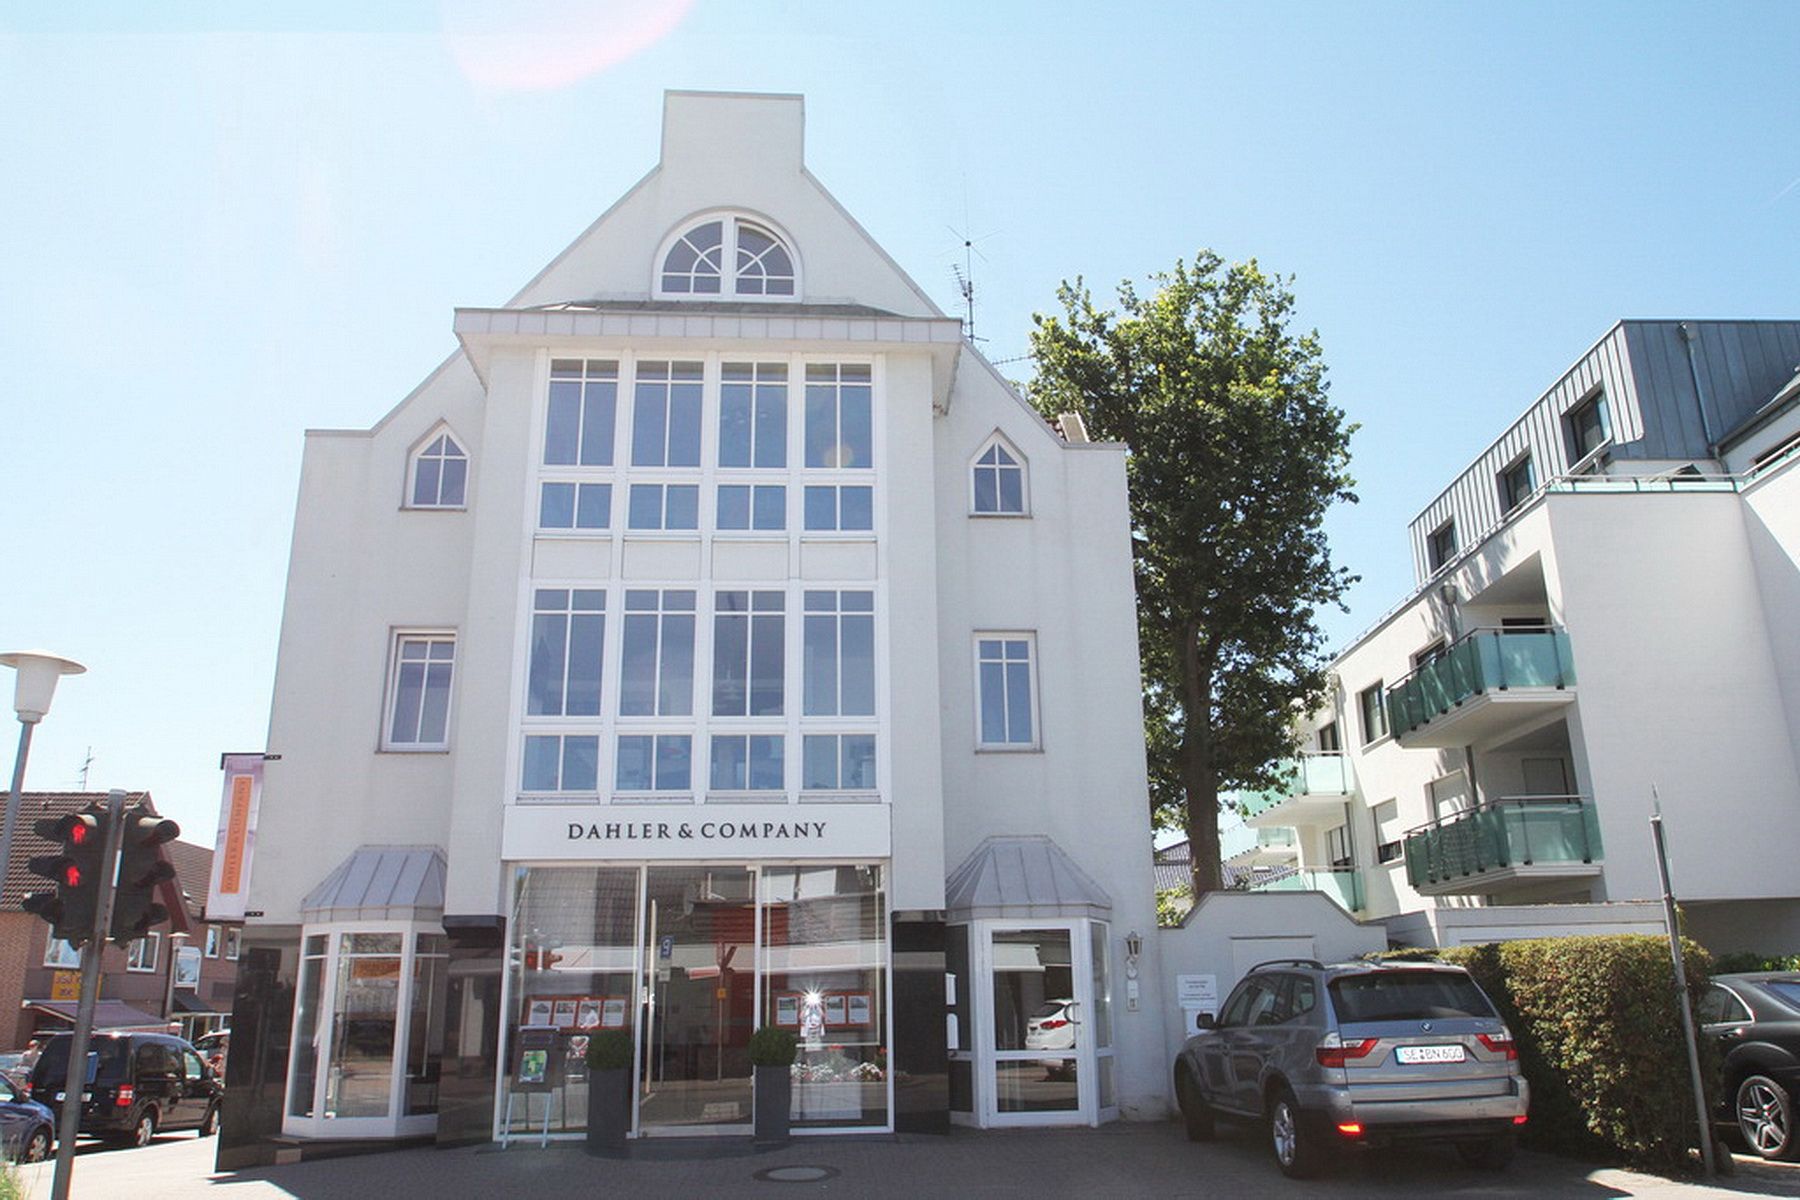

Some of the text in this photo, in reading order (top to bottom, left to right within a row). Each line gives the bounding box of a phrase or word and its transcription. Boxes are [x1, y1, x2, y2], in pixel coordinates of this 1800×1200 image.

[568, 822, 827, 840] DAHLER & COMPANY
